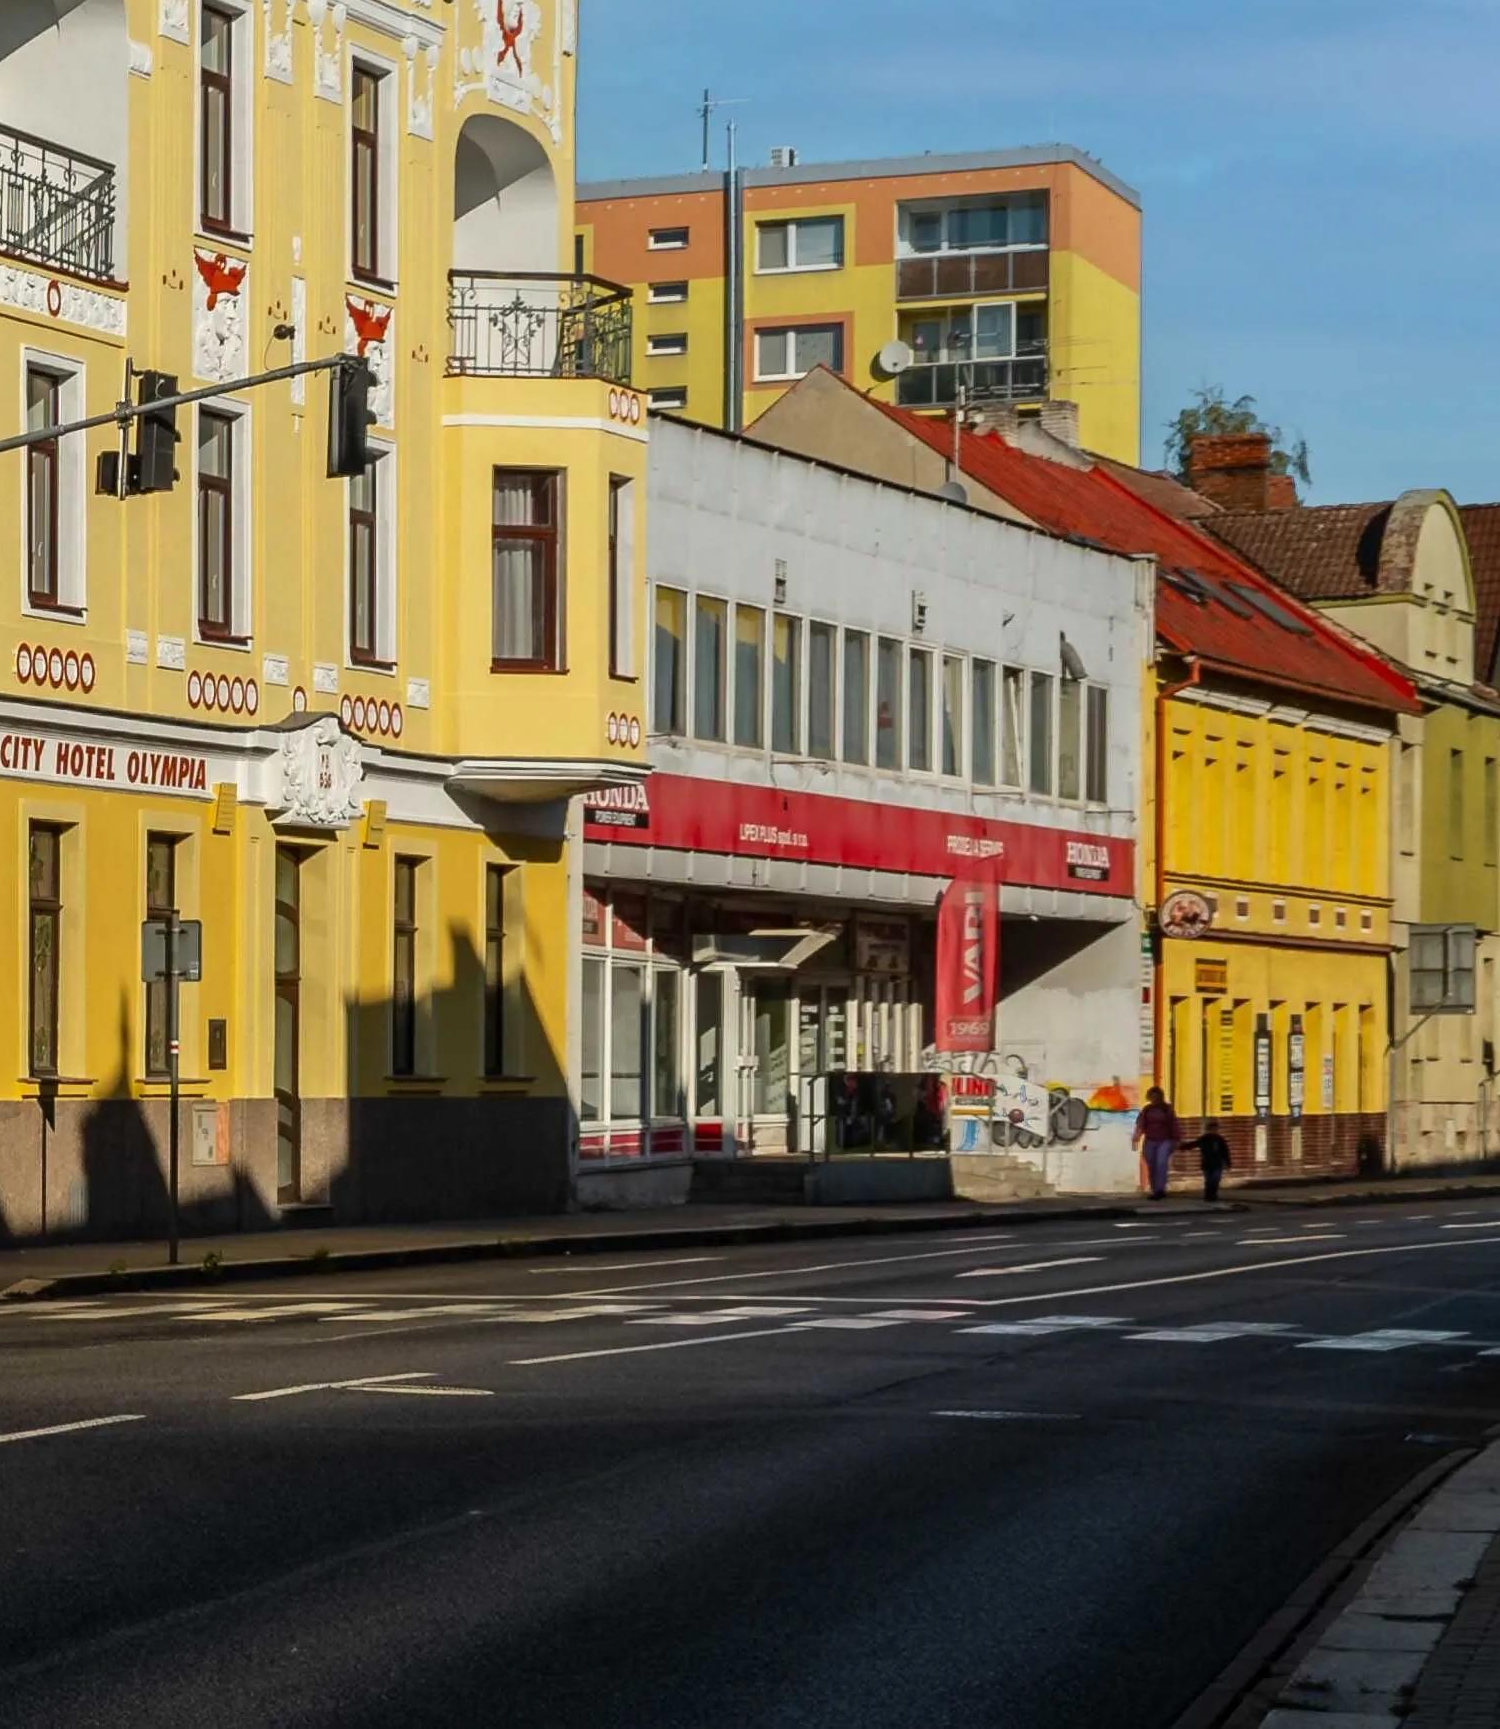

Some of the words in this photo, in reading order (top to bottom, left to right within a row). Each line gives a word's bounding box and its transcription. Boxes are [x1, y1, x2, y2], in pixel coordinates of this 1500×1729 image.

[0, 734, 46, 772] CITY
[55, 742, 115, 781] HOTEL
[127, 750, 207, 790] OLYMPIA
[583, 785, 649, 811] HONDA
[1066, 841, 1110, 868] HONDA
[963, 891, 984, 1005] VARI
[949, 1022, 989, 1035] 1969
